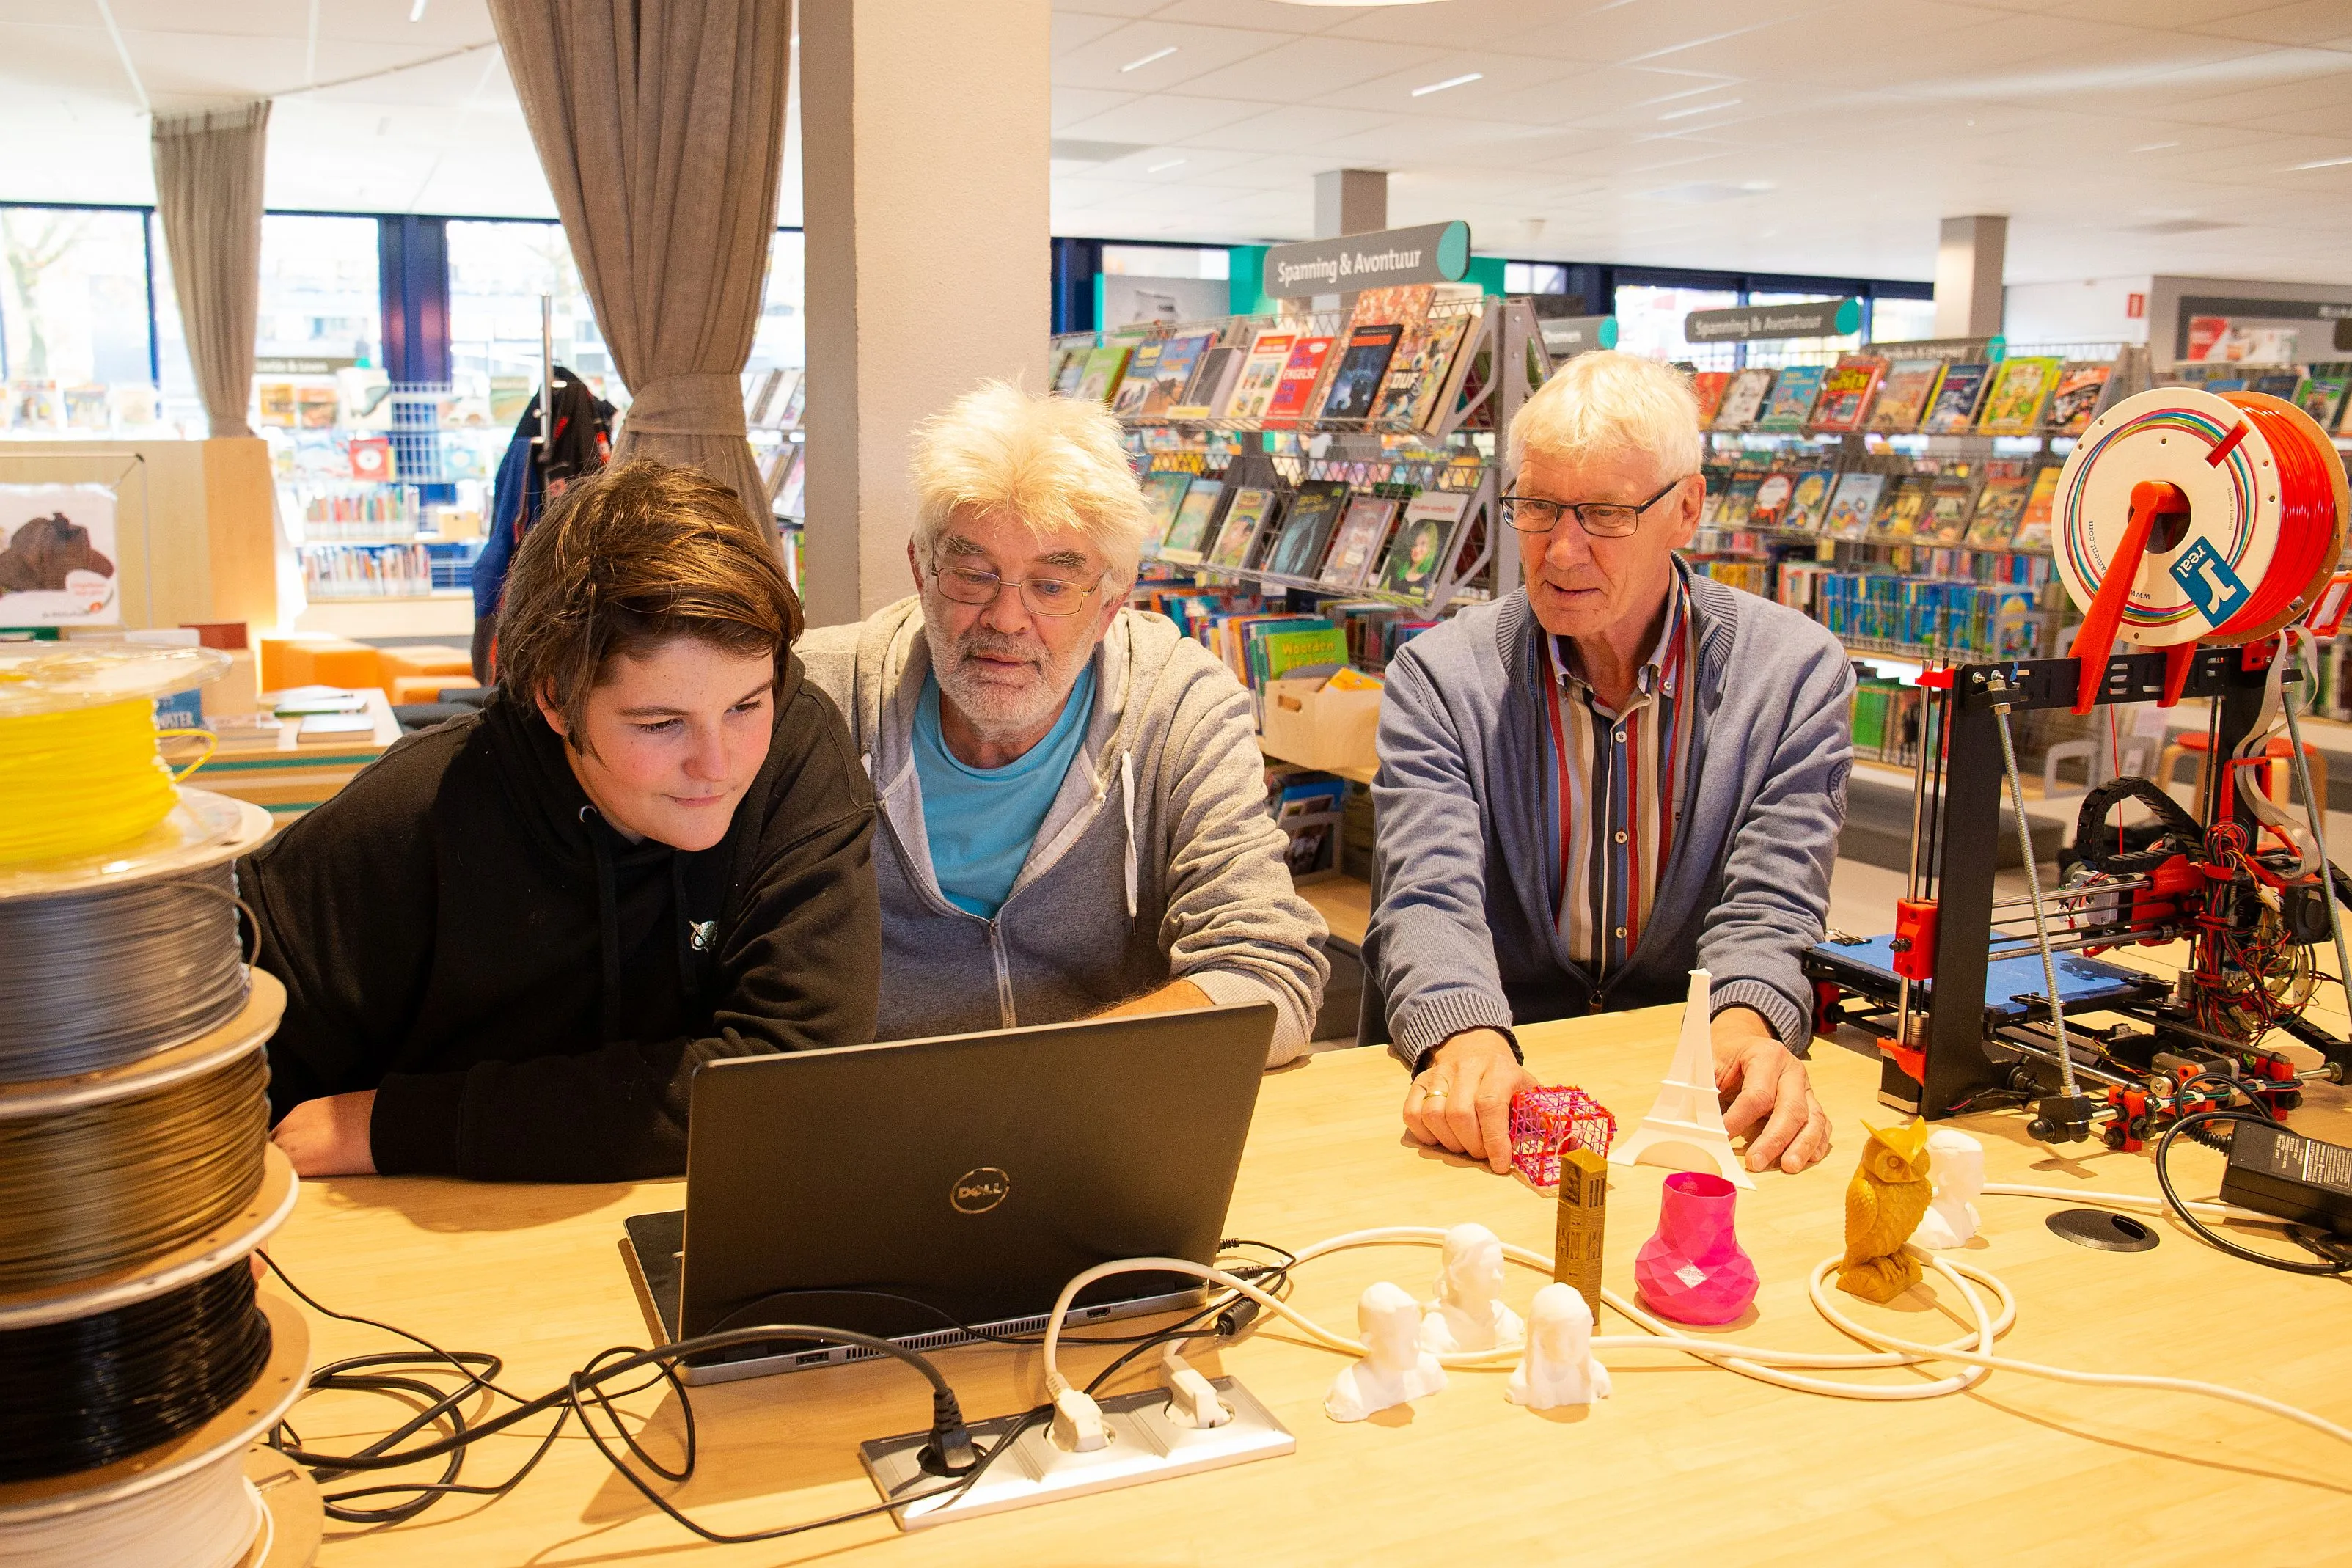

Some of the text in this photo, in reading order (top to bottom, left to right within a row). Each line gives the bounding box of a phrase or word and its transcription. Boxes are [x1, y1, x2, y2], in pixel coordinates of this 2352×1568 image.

[1278, 249, 1422, 287] Spanning & Avontuur
[2176, 545, 2207, 579] real
[958, 1182, 1003, 1199] DELL
